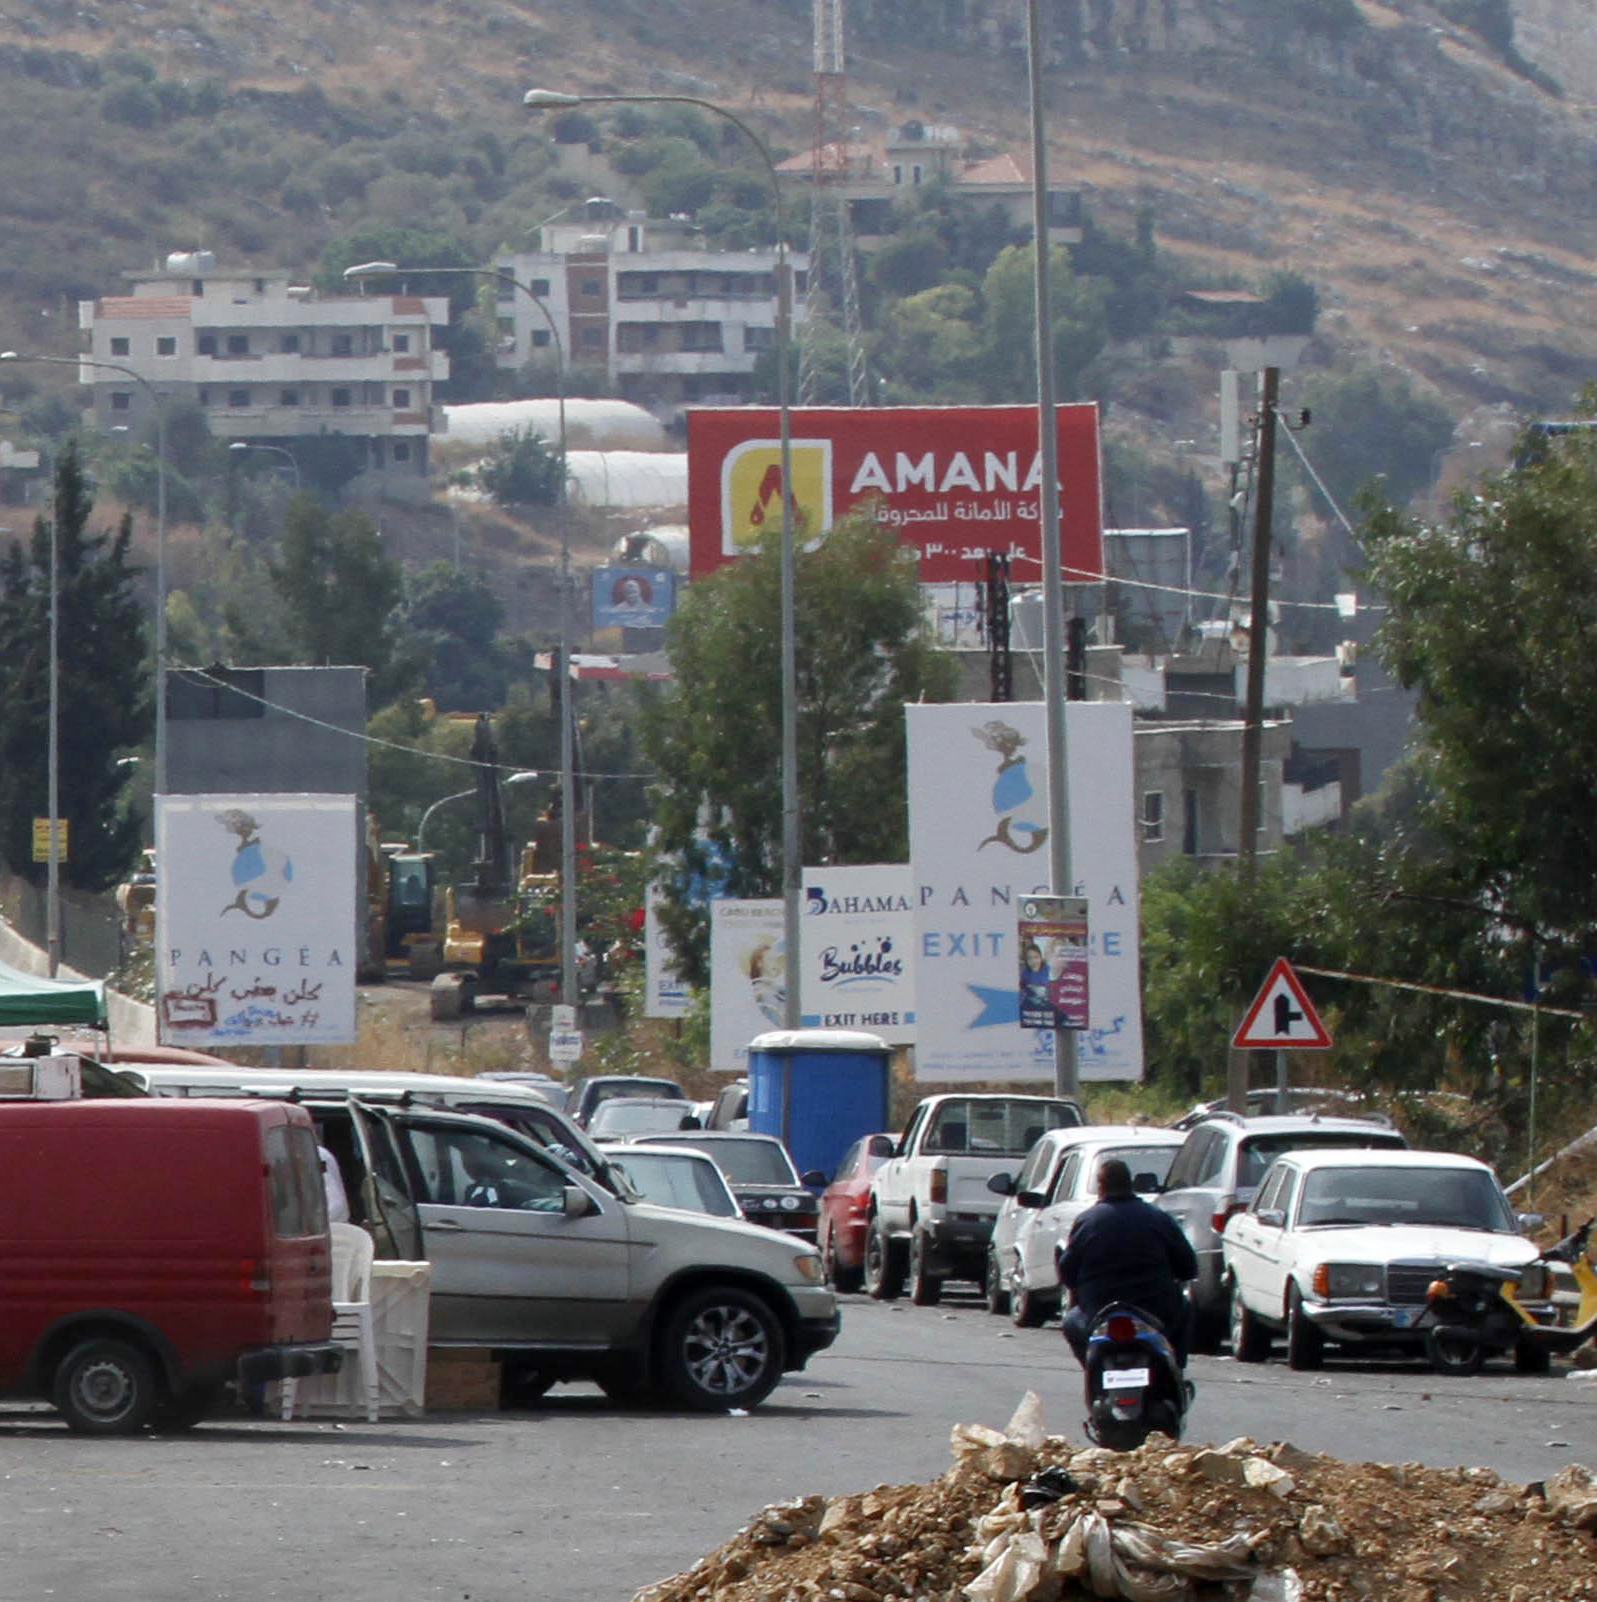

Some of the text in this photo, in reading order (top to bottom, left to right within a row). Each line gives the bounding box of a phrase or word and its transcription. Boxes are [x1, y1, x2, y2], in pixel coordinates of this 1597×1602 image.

[922, 931, 1005, 957] EXIT
[818, 945, 903, 982] Bubbles
[823, 1011, 900, 1027] EXIT HERE
